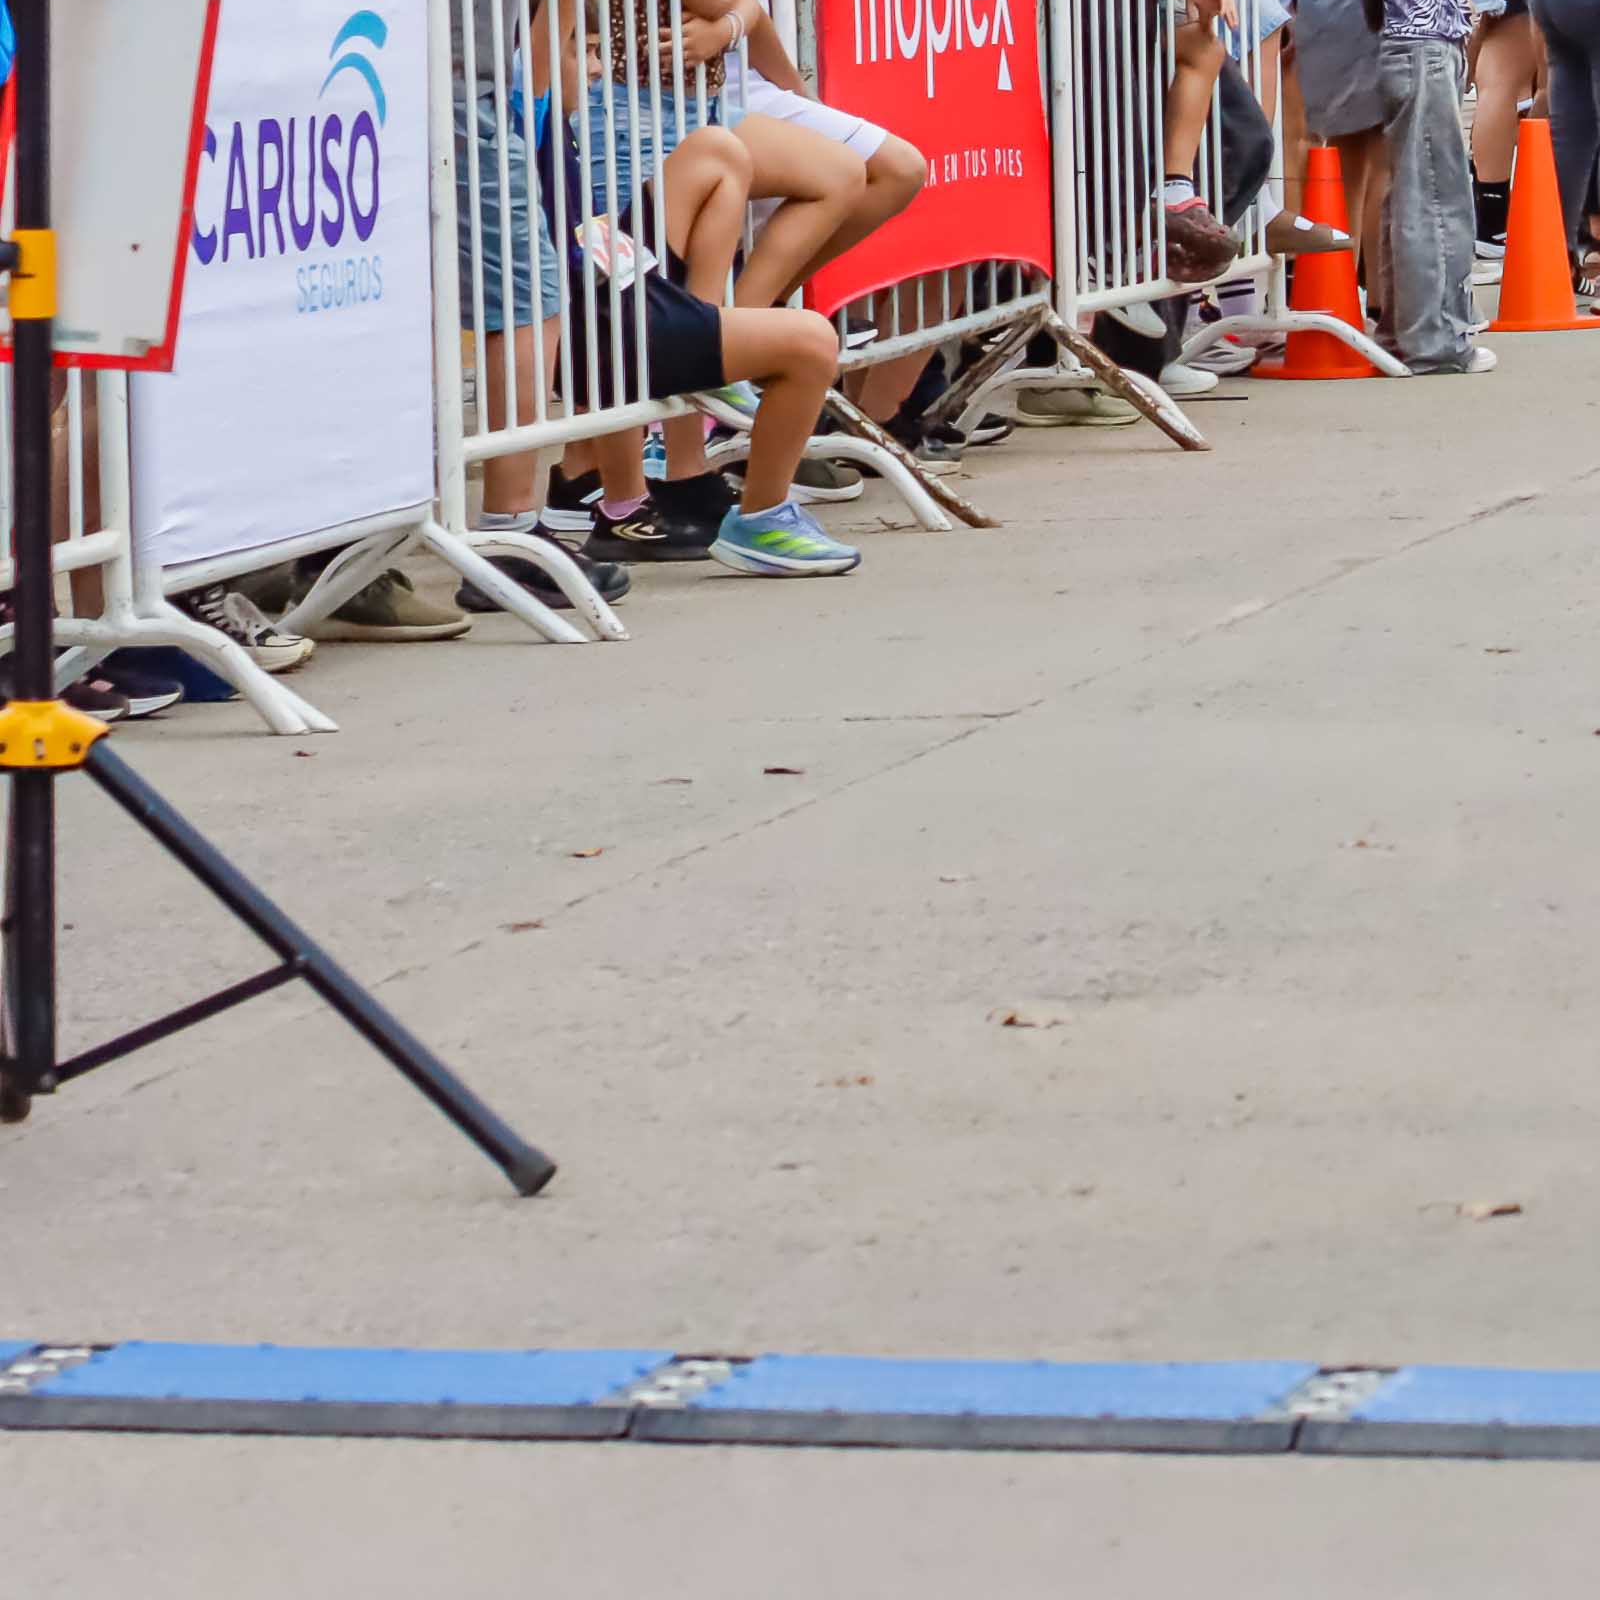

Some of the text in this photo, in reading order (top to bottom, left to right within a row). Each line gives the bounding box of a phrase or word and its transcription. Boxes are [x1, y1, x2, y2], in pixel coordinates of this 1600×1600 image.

[944, 153, 958, 183] EN
[963, 147, 988, 178] TUS
[994, 147, 1023, 177] PIES
[297, 255, 383, 314] SEGUROS
